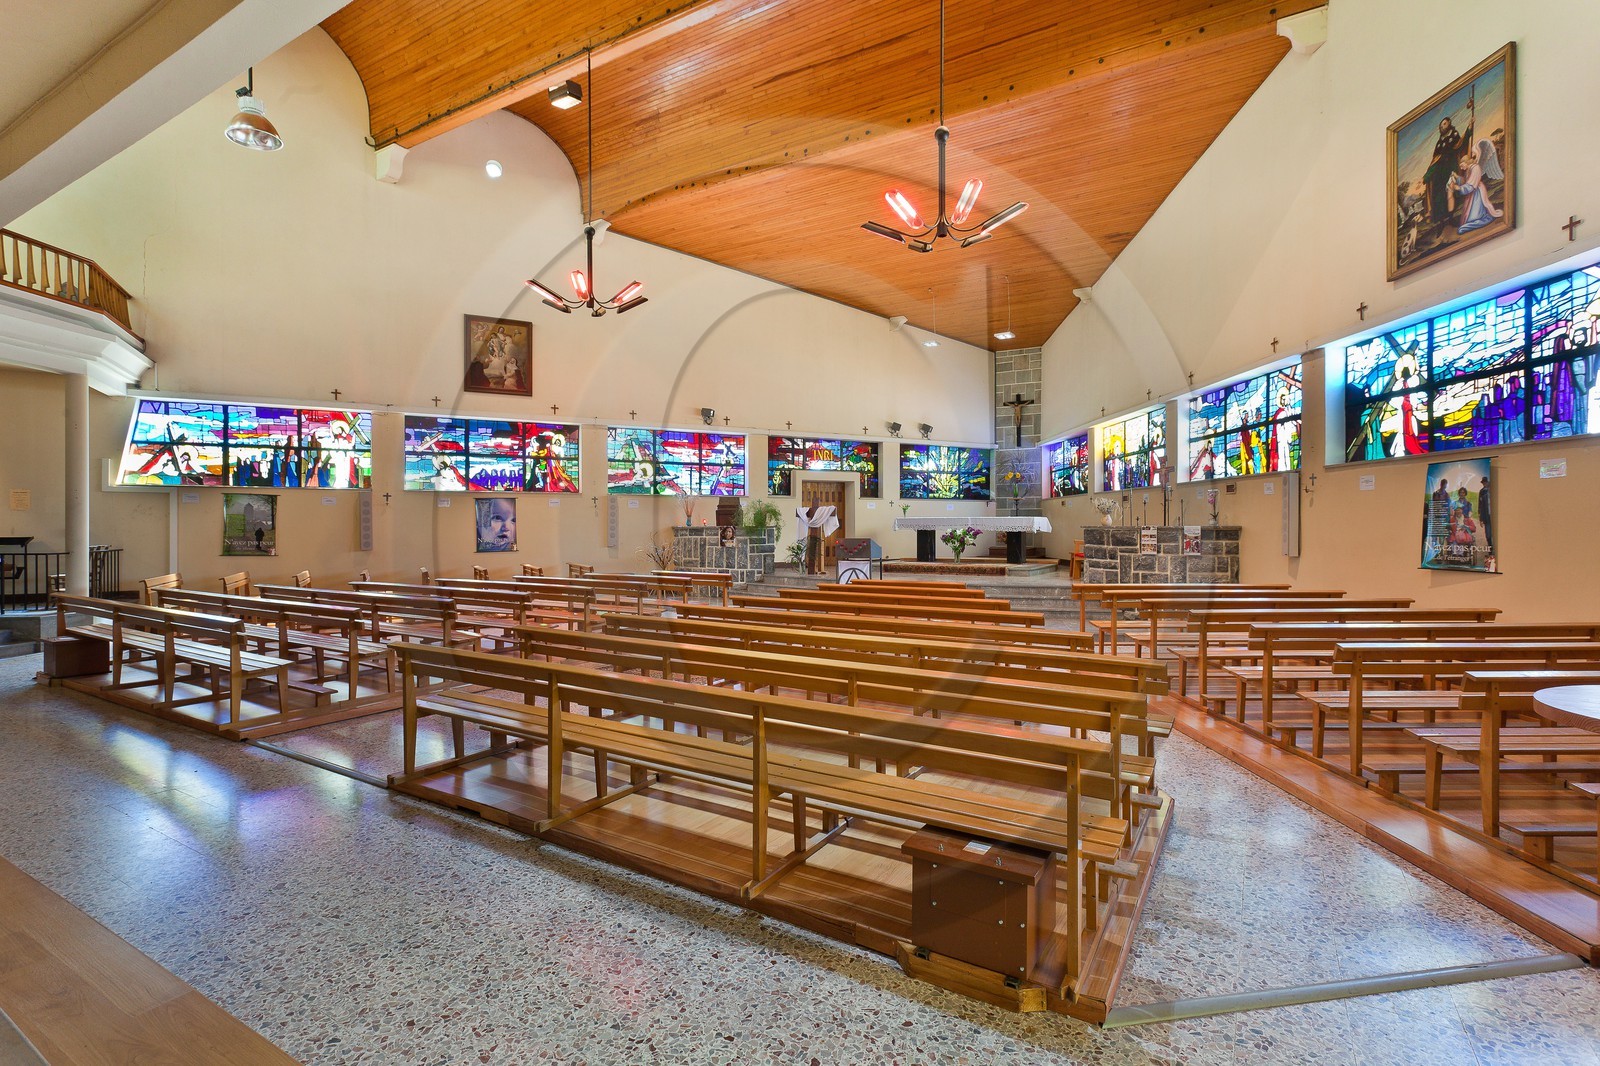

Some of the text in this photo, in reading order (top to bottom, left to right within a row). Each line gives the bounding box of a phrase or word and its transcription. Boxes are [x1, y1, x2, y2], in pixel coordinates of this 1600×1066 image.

[813, 449, 832, 461] INRI
[1425, 541, 1492, 555] N'ayez pas peur
